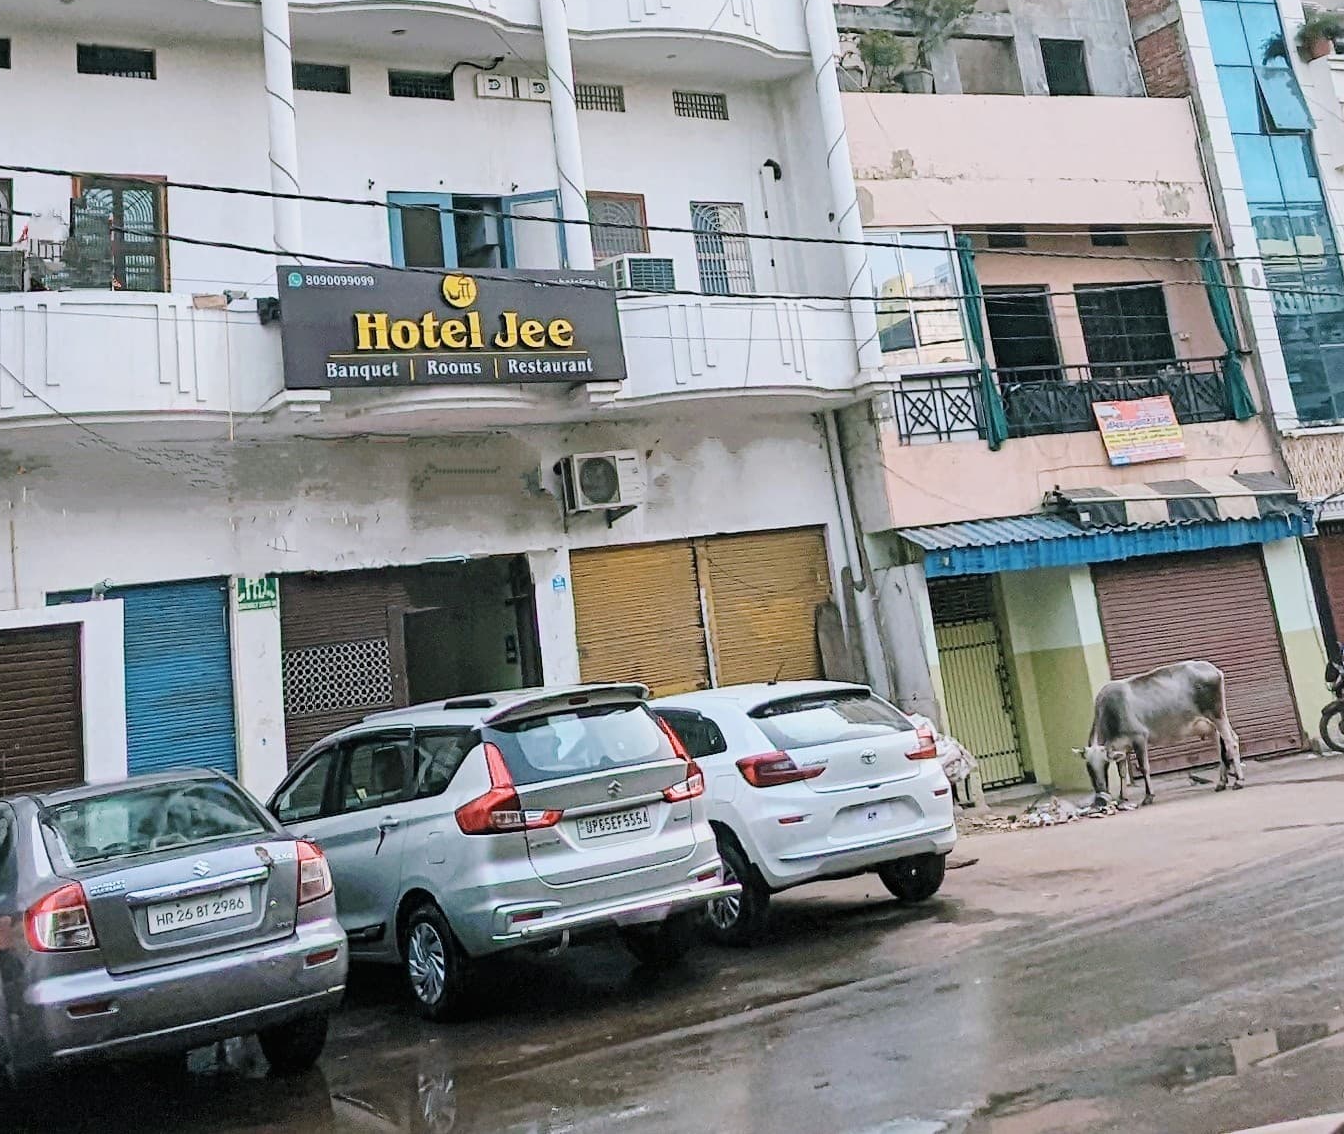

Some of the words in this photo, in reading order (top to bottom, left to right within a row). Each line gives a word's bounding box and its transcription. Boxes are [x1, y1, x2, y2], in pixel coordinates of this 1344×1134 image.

[305, 274, 375, 287] 8090099099
[353, 310, 485, 351] Hotel
[494, 311, 575, 349] Jee
[326, 362, 399, 381] Banquet
[427, 360, 482, 375] Rooms
[508, 357, 594, 374] Restaurant
[155, 912, 174, 927] HR
[176, 908, 193, 922] 26
[212, 898, 245, 916] 2986
